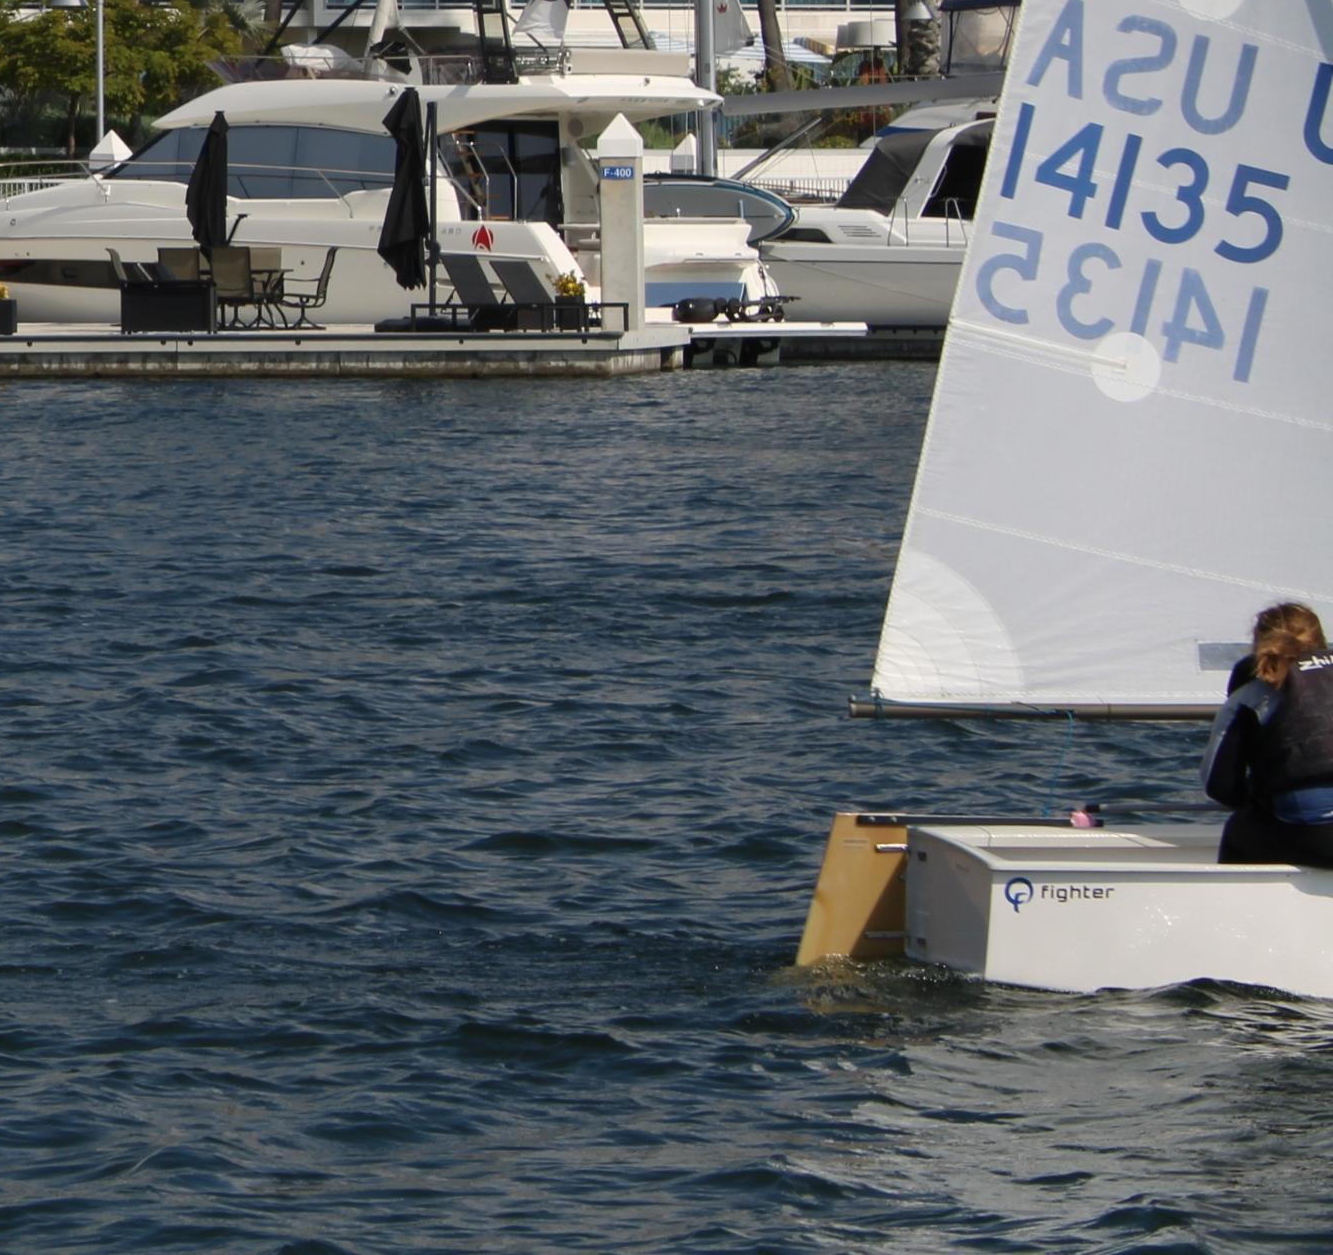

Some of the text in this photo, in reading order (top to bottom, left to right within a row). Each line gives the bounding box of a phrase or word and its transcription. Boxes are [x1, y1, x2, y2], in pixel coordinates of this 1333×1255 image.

[604, 167, 632, 178] F-400
[1000, 102, 1290, 264] 14135
[1298, 655, 1333, 671] zhi
[1041, 884, 1115, 903] fighter
